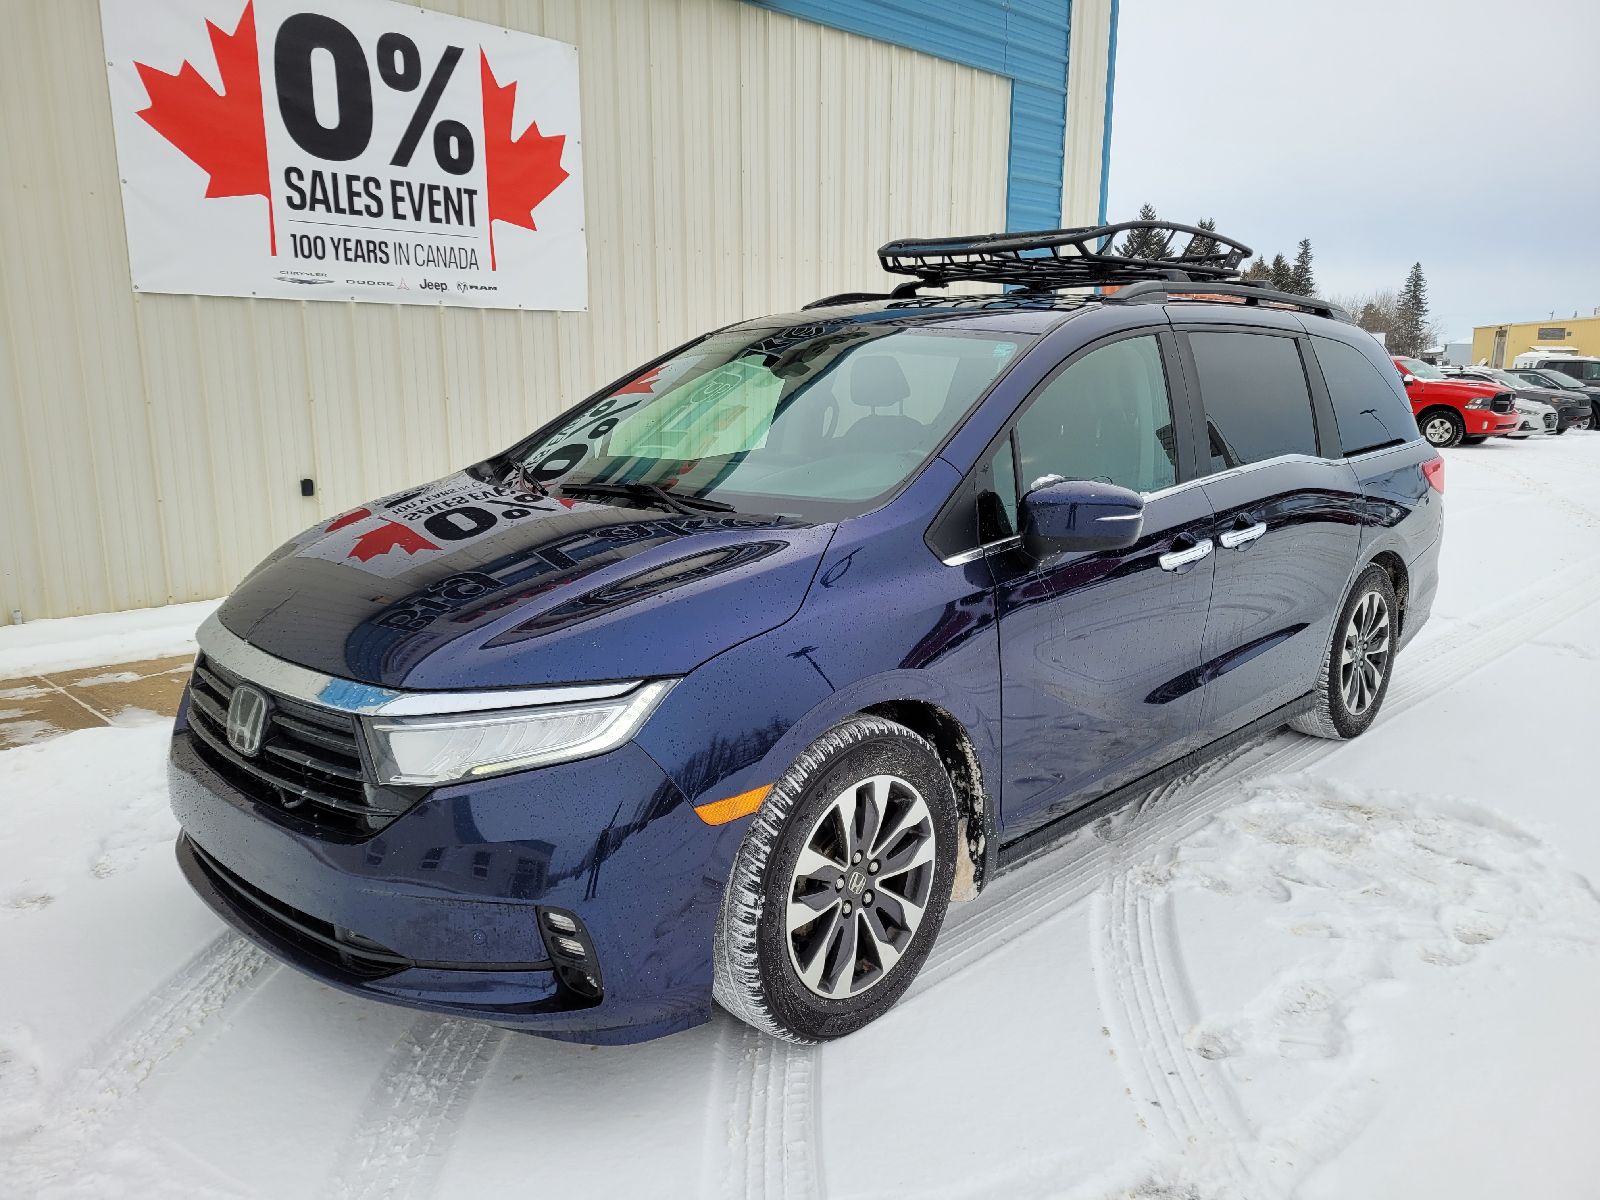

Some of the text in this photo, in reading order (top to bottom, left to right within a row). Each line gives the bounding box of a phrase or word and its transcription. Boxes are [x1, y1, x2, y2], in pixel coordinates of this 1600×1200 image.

[274, 13, 474, 175] 0%
[284, 166, 478, 228] SALES EVENT
[290, 233, 480, 272] 100 YEARS IN CANADA
[279, 270, 328, 278] CHRYSLER
[419, 278, 449, 293] Jeep
